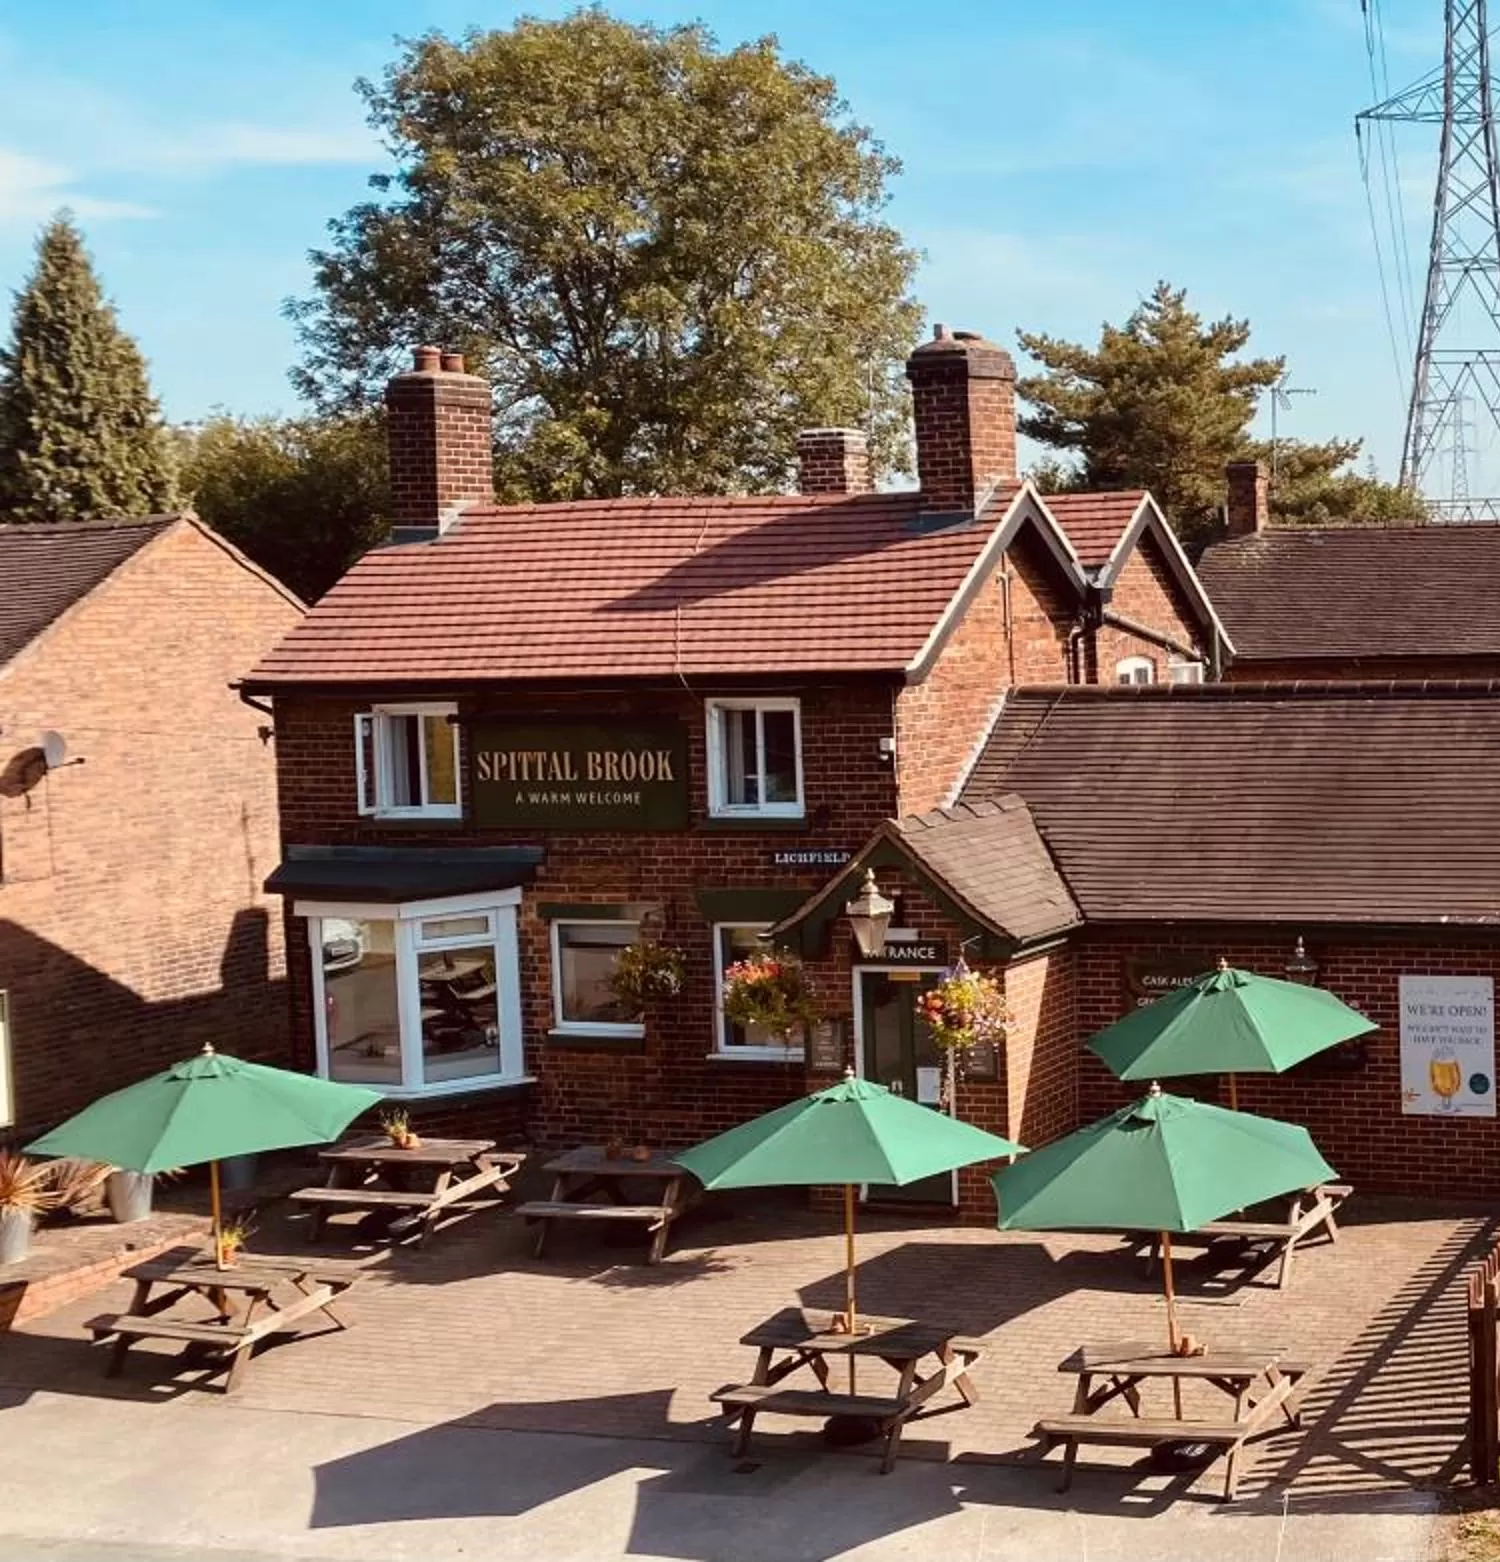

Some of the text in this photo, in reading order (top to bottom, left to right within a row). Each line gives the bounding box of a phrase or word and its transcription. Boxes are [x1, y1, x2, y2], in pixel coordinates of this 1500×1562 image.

[477, 751, 674, 781] SPITTAL BROOK
[515, 792, 641, 804] A WARM WELCOME
[775, 852, 851, 863] LICHFIELD
[1448, 1004, 1487, 1016] OPEN!
